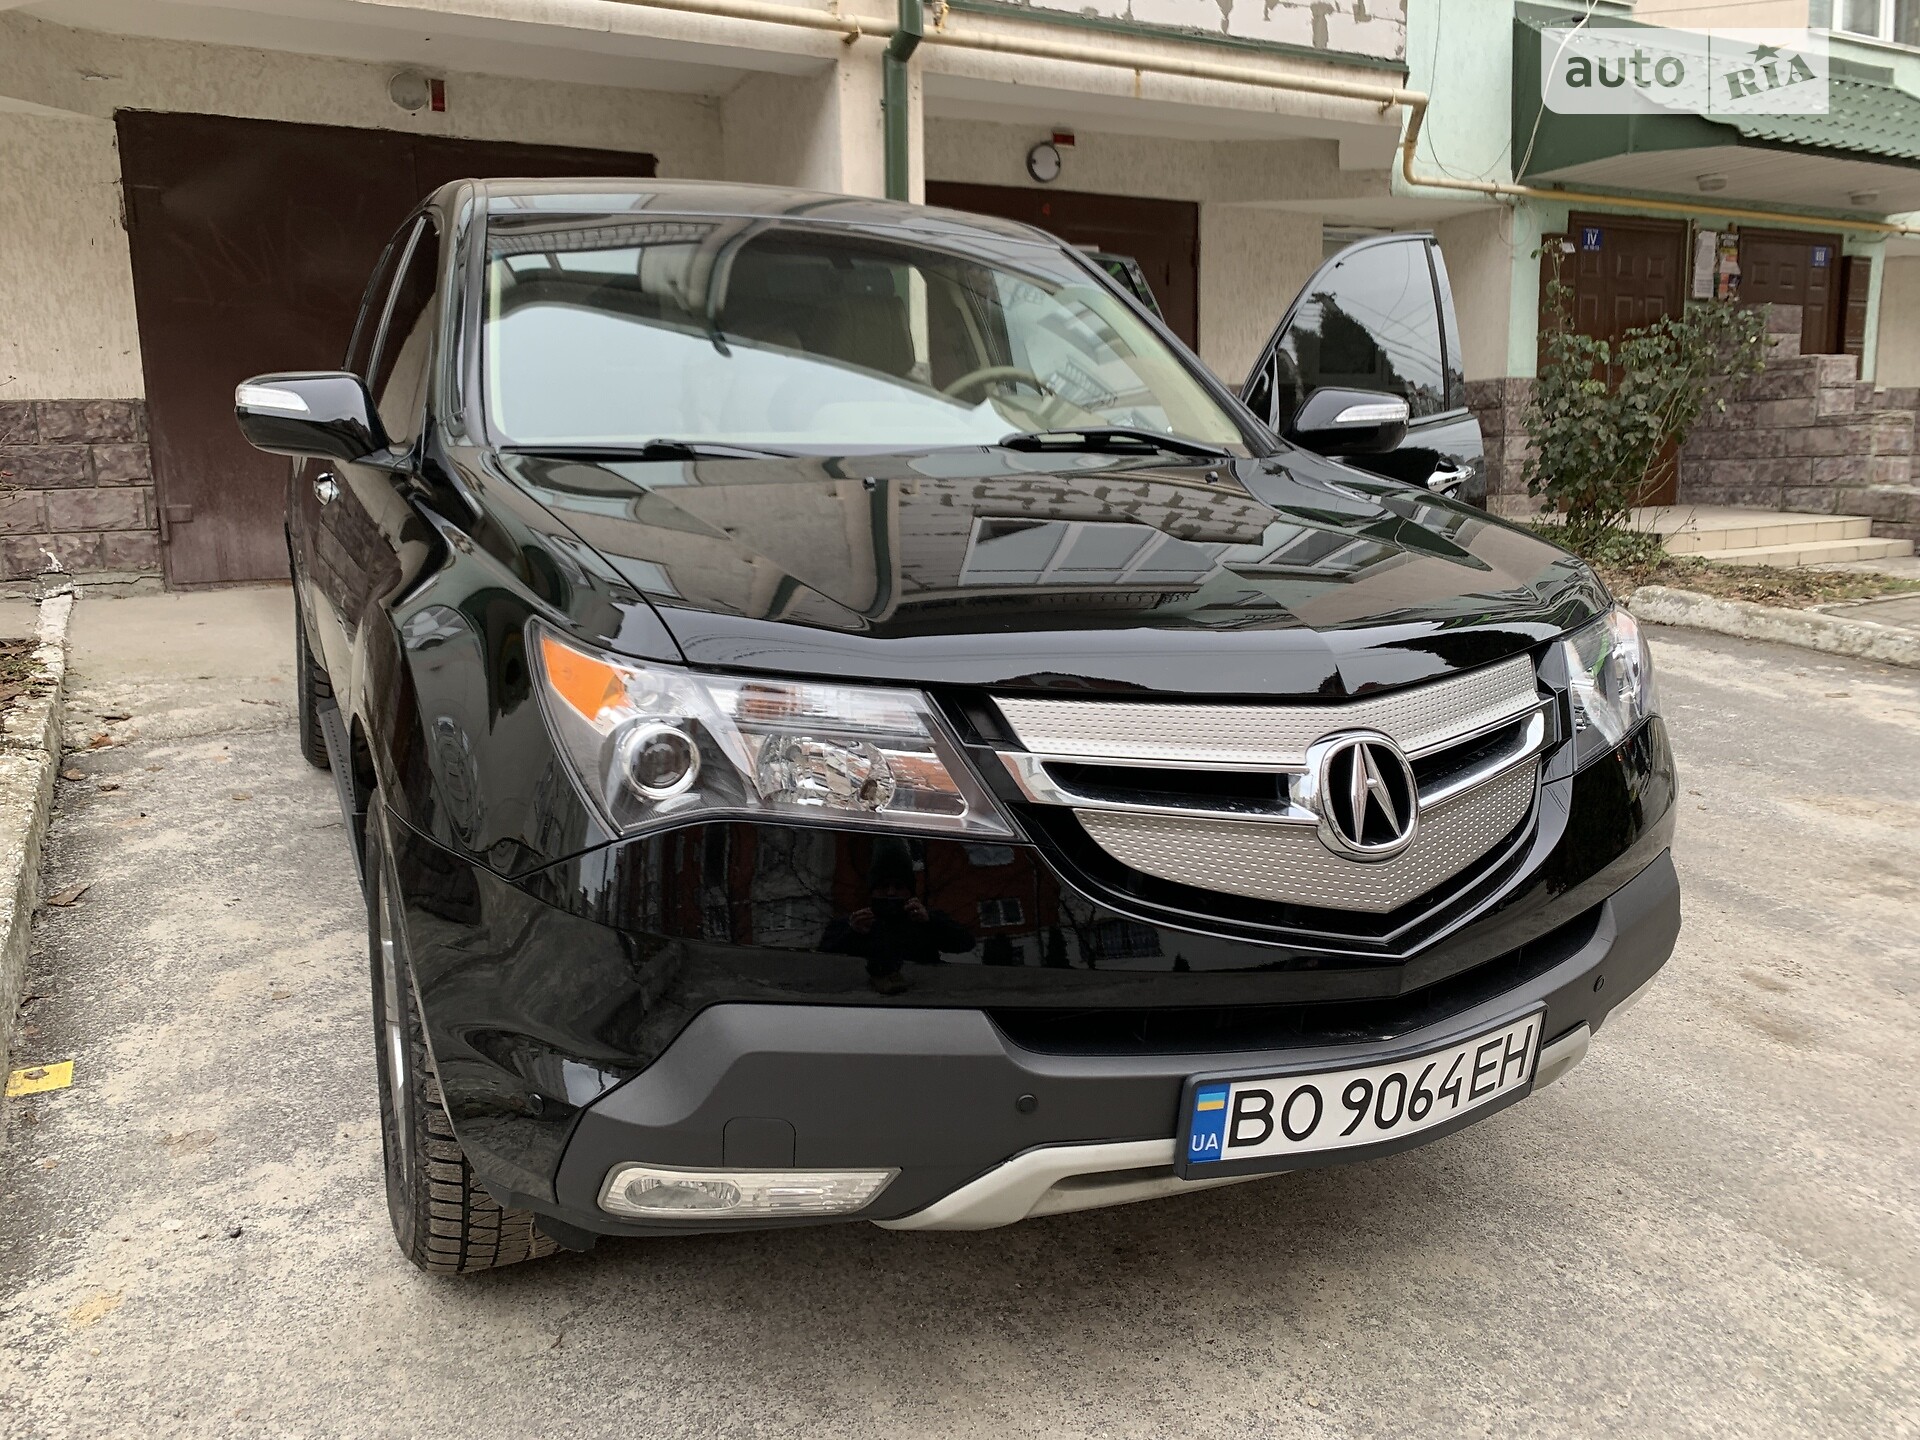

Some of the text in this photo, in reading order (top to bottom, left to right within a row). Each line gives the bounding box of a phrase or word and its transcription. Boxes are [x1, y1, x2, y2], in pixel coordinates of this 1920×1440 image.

[1587, 233, 1597, 245] IV
[1227, 1084, 1324, 1148] BO
[1191, 1133, 1219, 1152] UA
